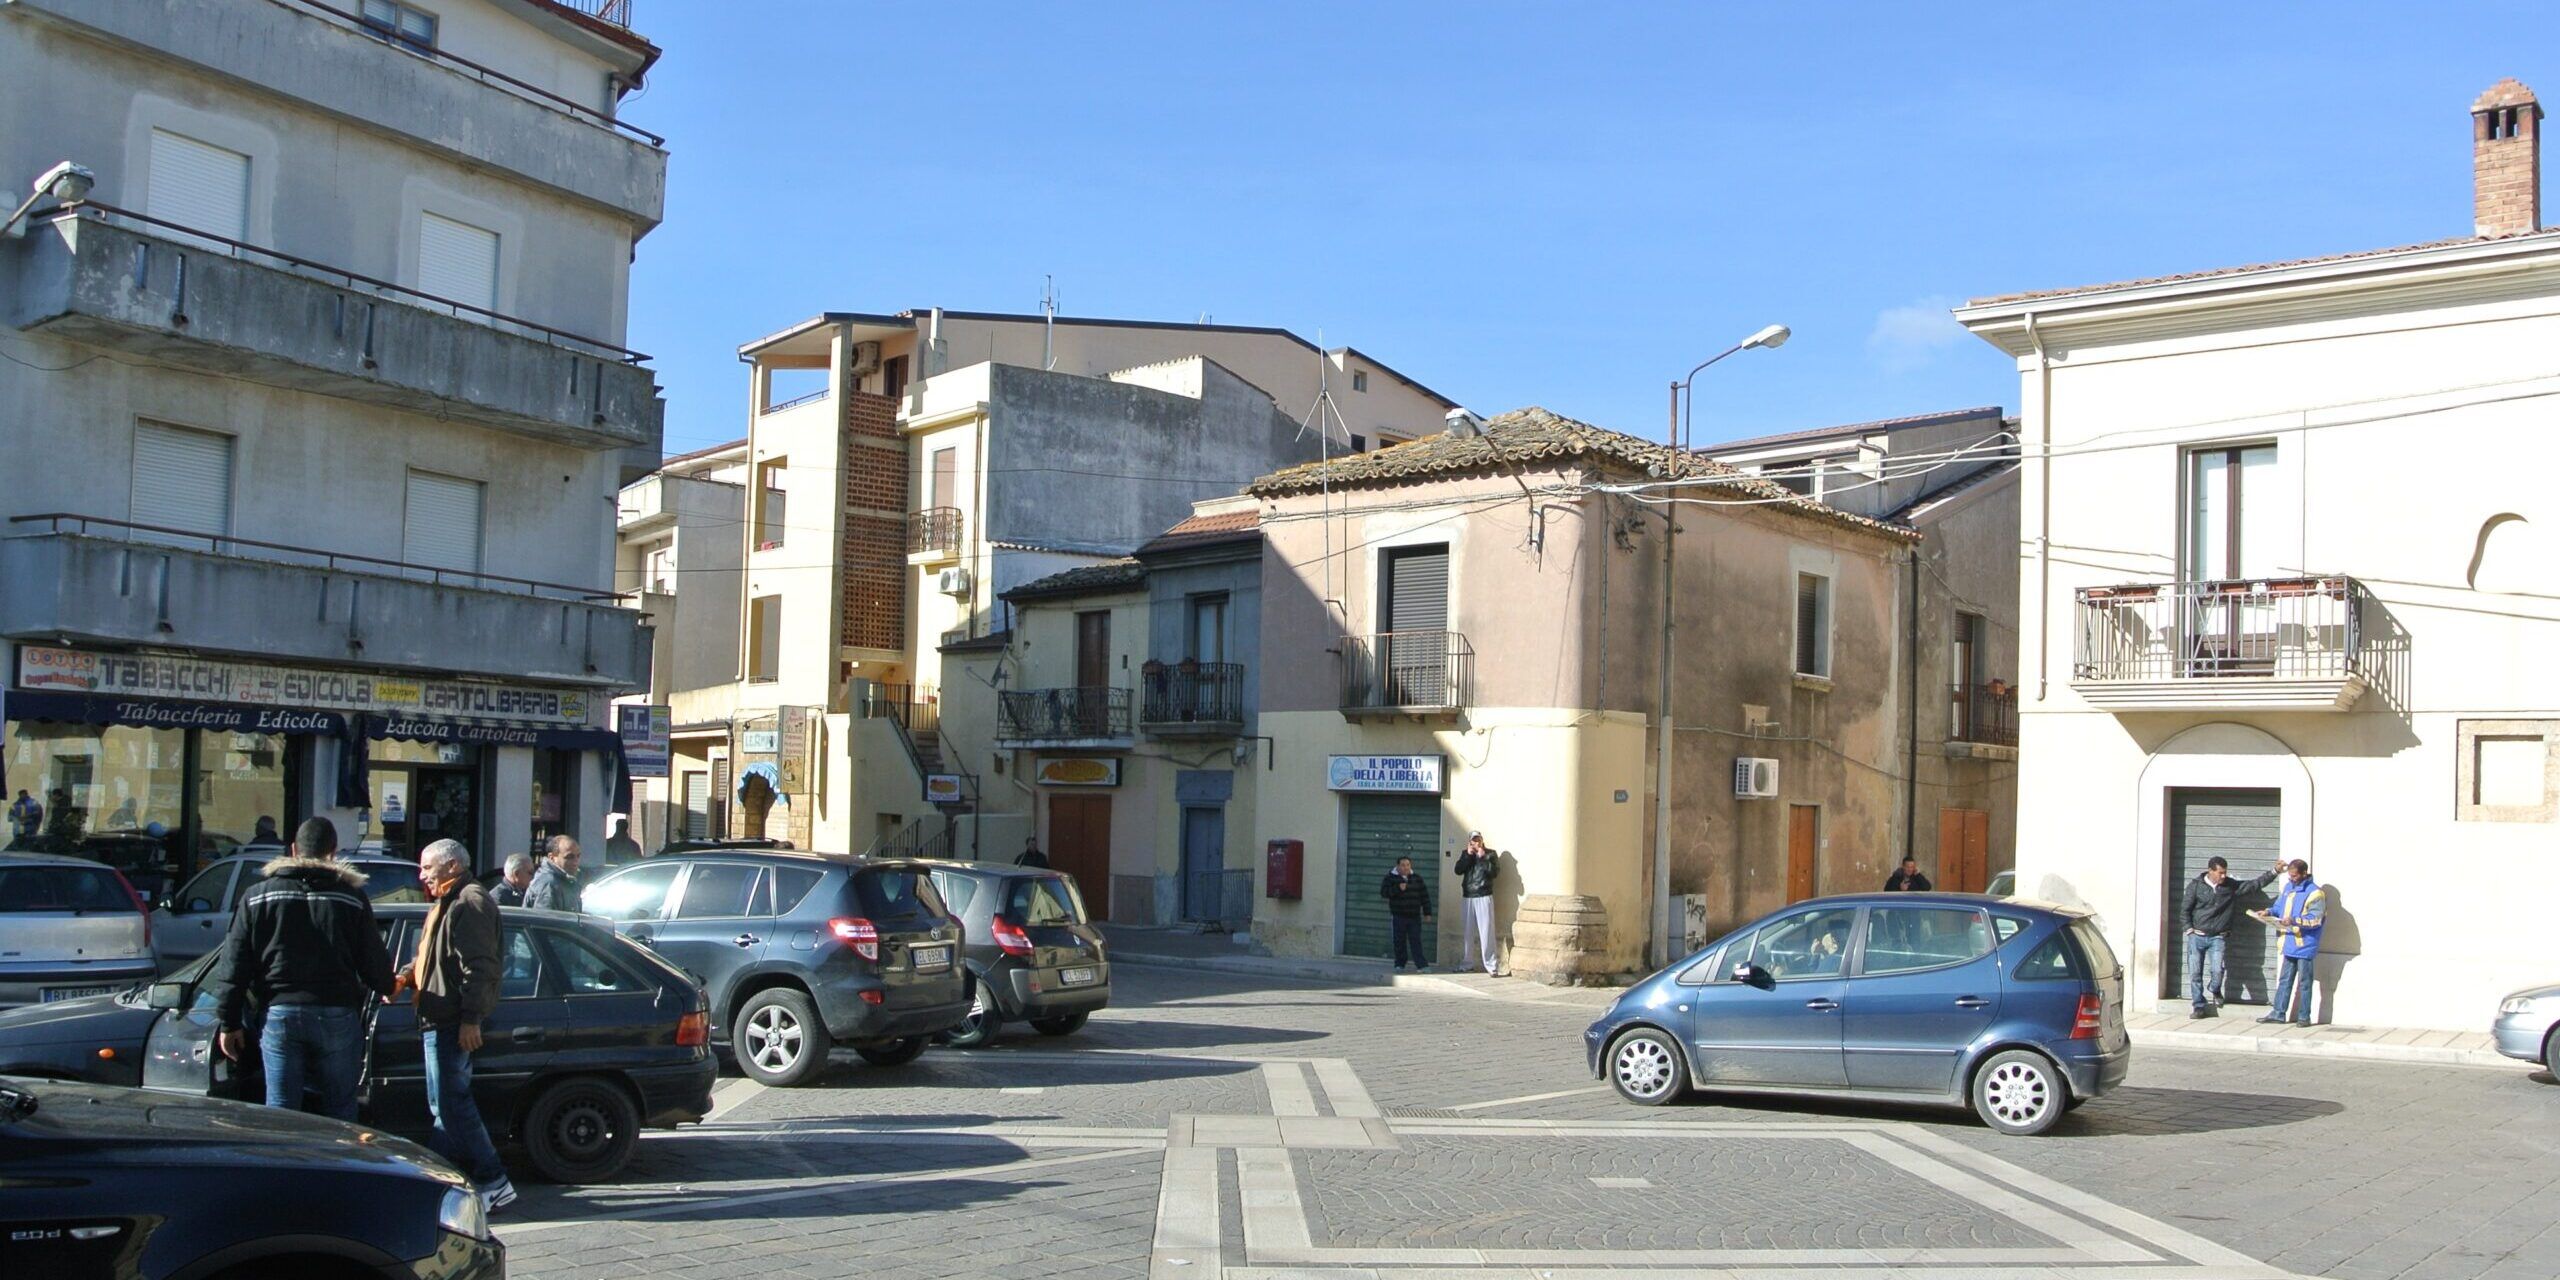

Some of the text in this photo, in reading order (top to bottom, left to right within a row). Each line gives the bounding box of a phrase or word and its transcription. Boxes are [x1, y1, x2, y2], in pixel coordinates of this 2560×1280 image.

[101, 658, 231, 695] TABACCHI
[285, 673, 371, 703] EDICOLA
[424, 684, 558, 716] CARTOLIBRERIA
[117, 702, 329, 729] Tabaccheria Edicola
[385, 718, 538, 743] Edicola Cartoleria
[1354, 769, 1386, 781] DELLA
[1369, 758, 1422, 769] IL POPOLO
